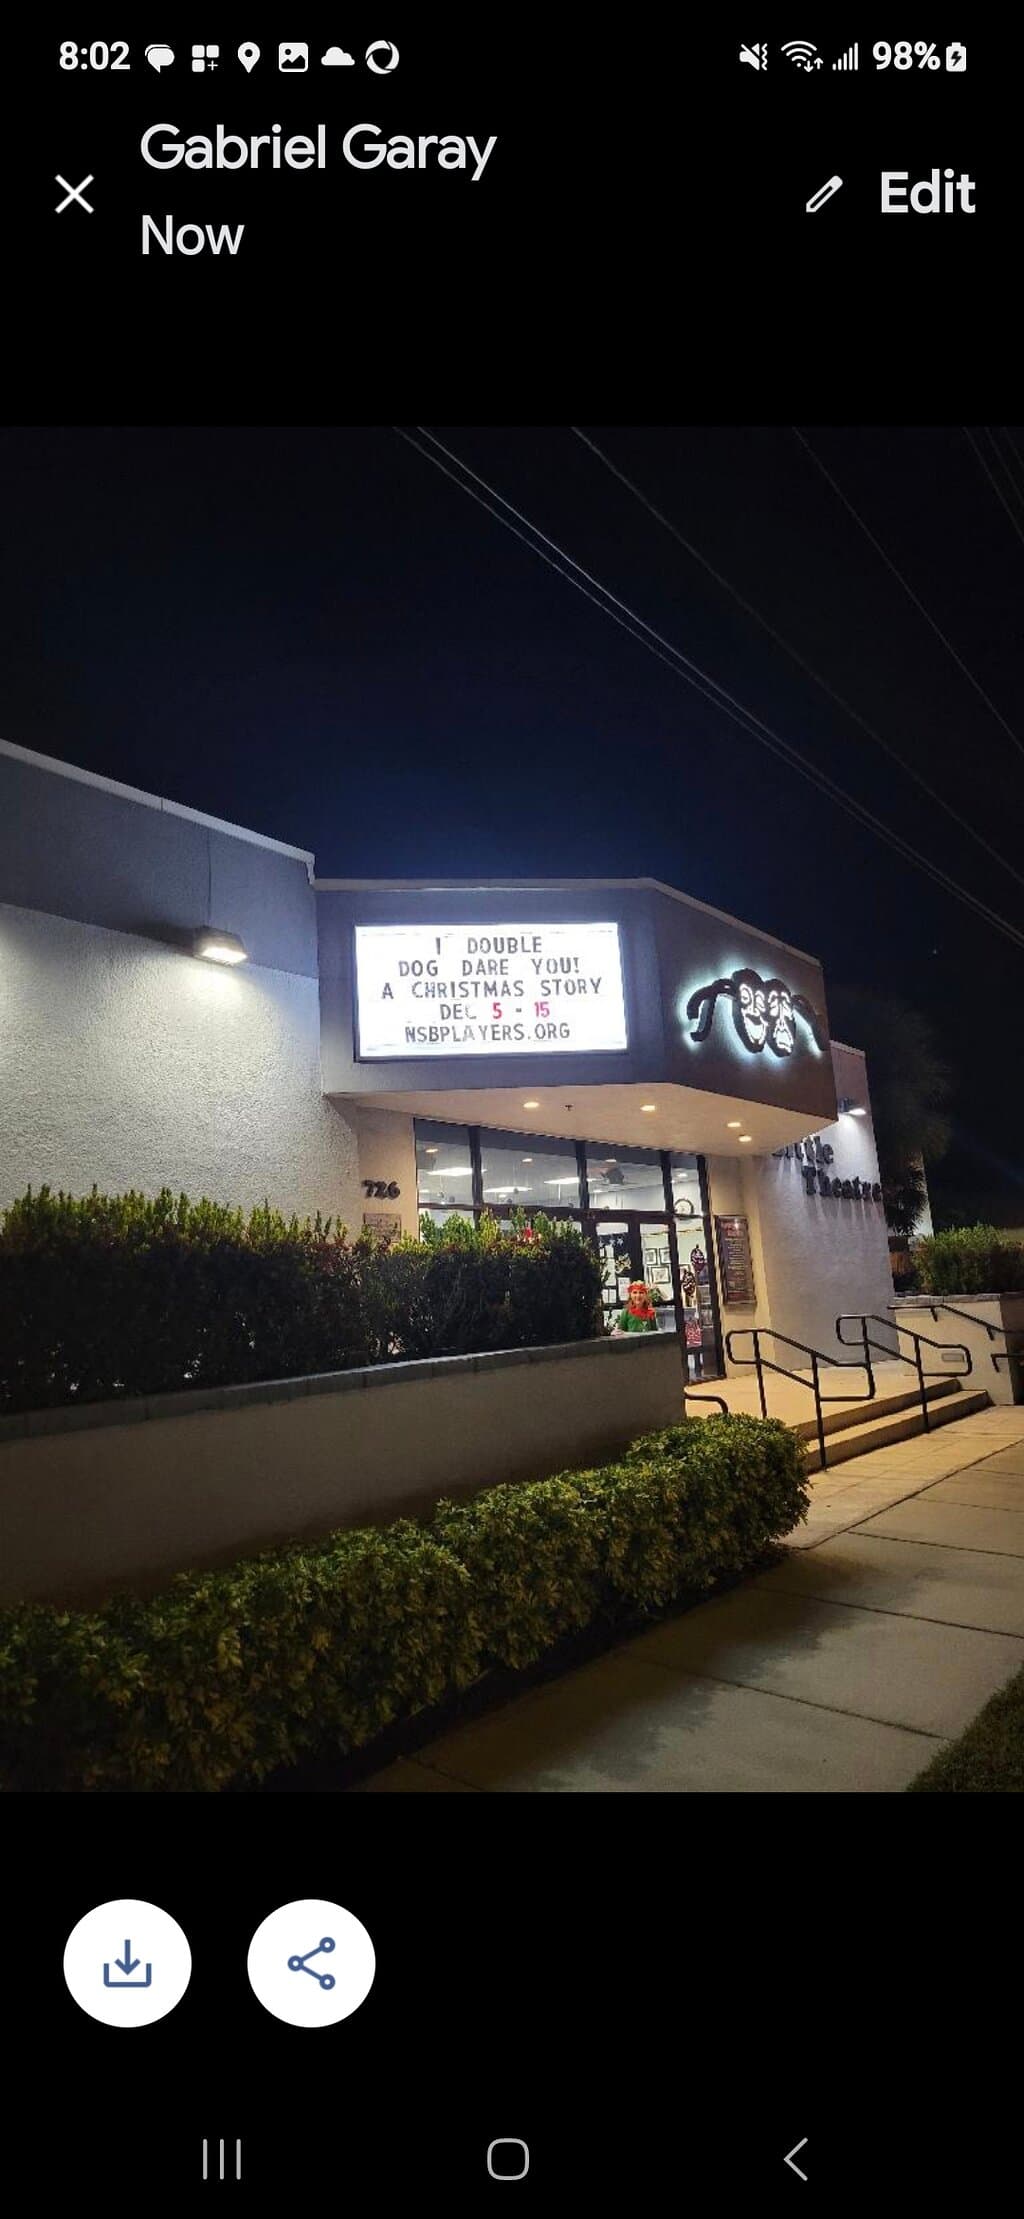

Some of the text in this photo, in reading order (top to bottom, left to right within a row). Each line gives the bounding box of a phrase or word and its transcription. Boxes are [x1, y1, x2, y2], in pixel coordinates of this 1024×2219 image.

[467, 936, 542, 954] DOUBLE
[398, 957, 580, 977] DOG DARE YOU!
[381, 977, 602, 999] A CHRISTMAS STORY
[440, 1003, 477, 1020] DEC
[492, 1002, 503, 1019] 5
[534, 1001, 550, 1018] 15
[404, 1023, 570, 1043] NSBPLAYERS.ORG
[361, 1180, 401, 1200] 726
